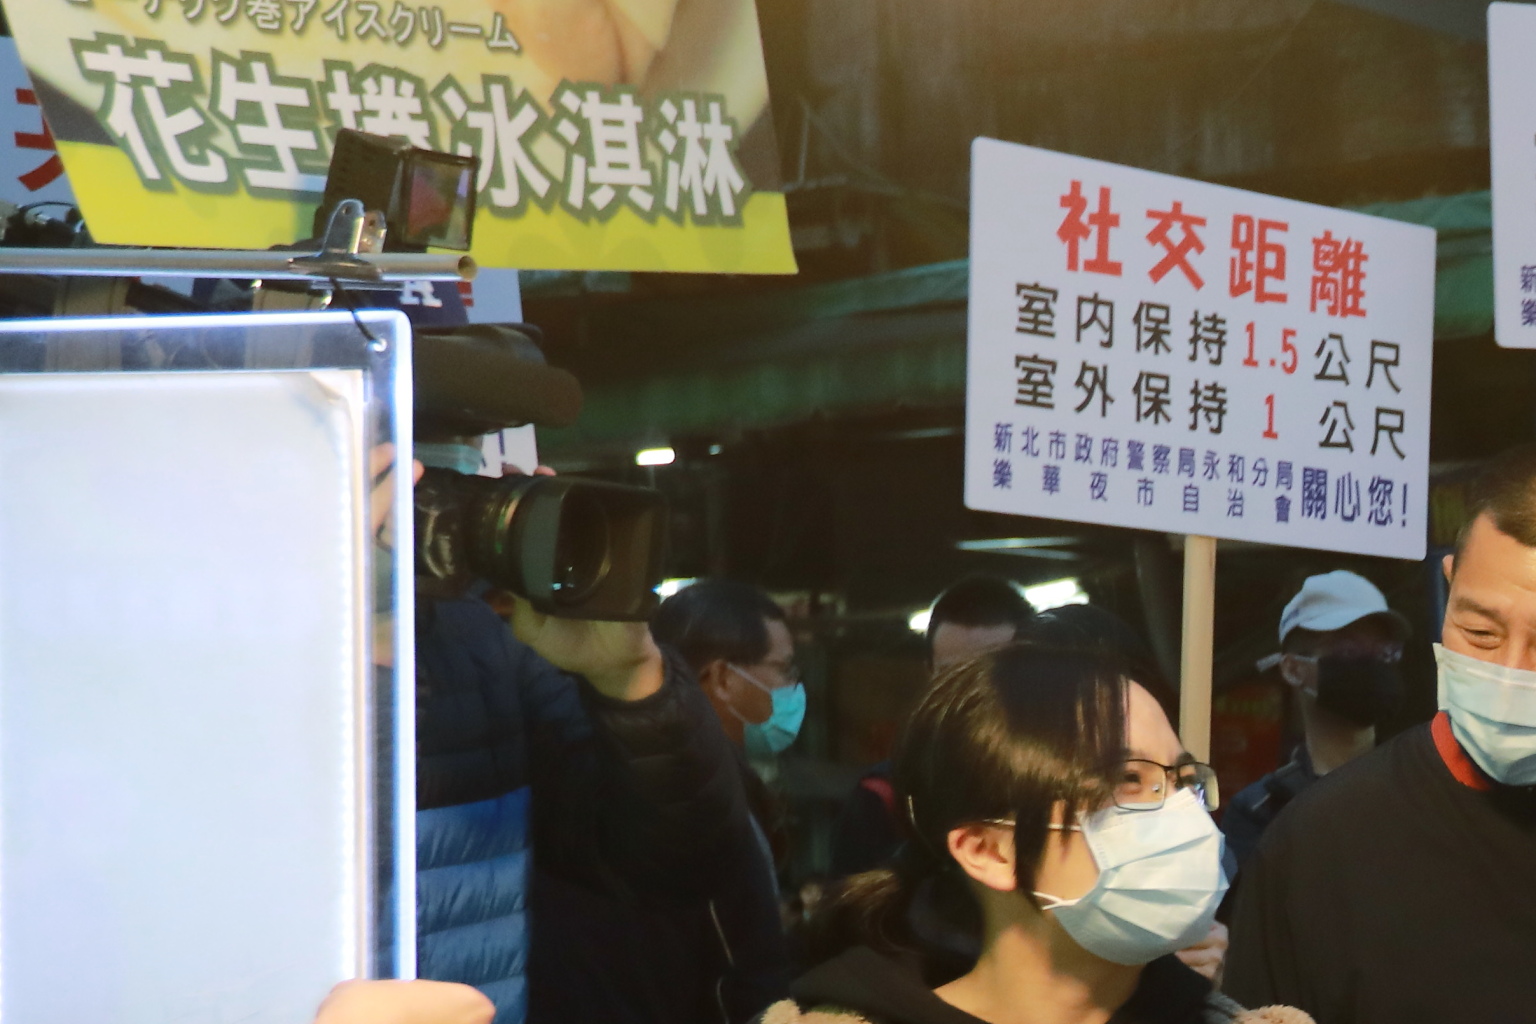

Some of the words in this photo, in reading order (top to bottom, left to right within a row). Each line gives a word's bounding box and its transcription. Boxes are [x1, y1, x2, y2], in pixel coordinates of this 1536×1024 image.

[1056, 179, 1370, 319] 社交距離
[993, 421, 1294, 491] 新北市政府警察局永和分局
[993, 457, 1293, 524] 樂華夜市自治會
[1300, 465, 1409, 528] 關心您!
